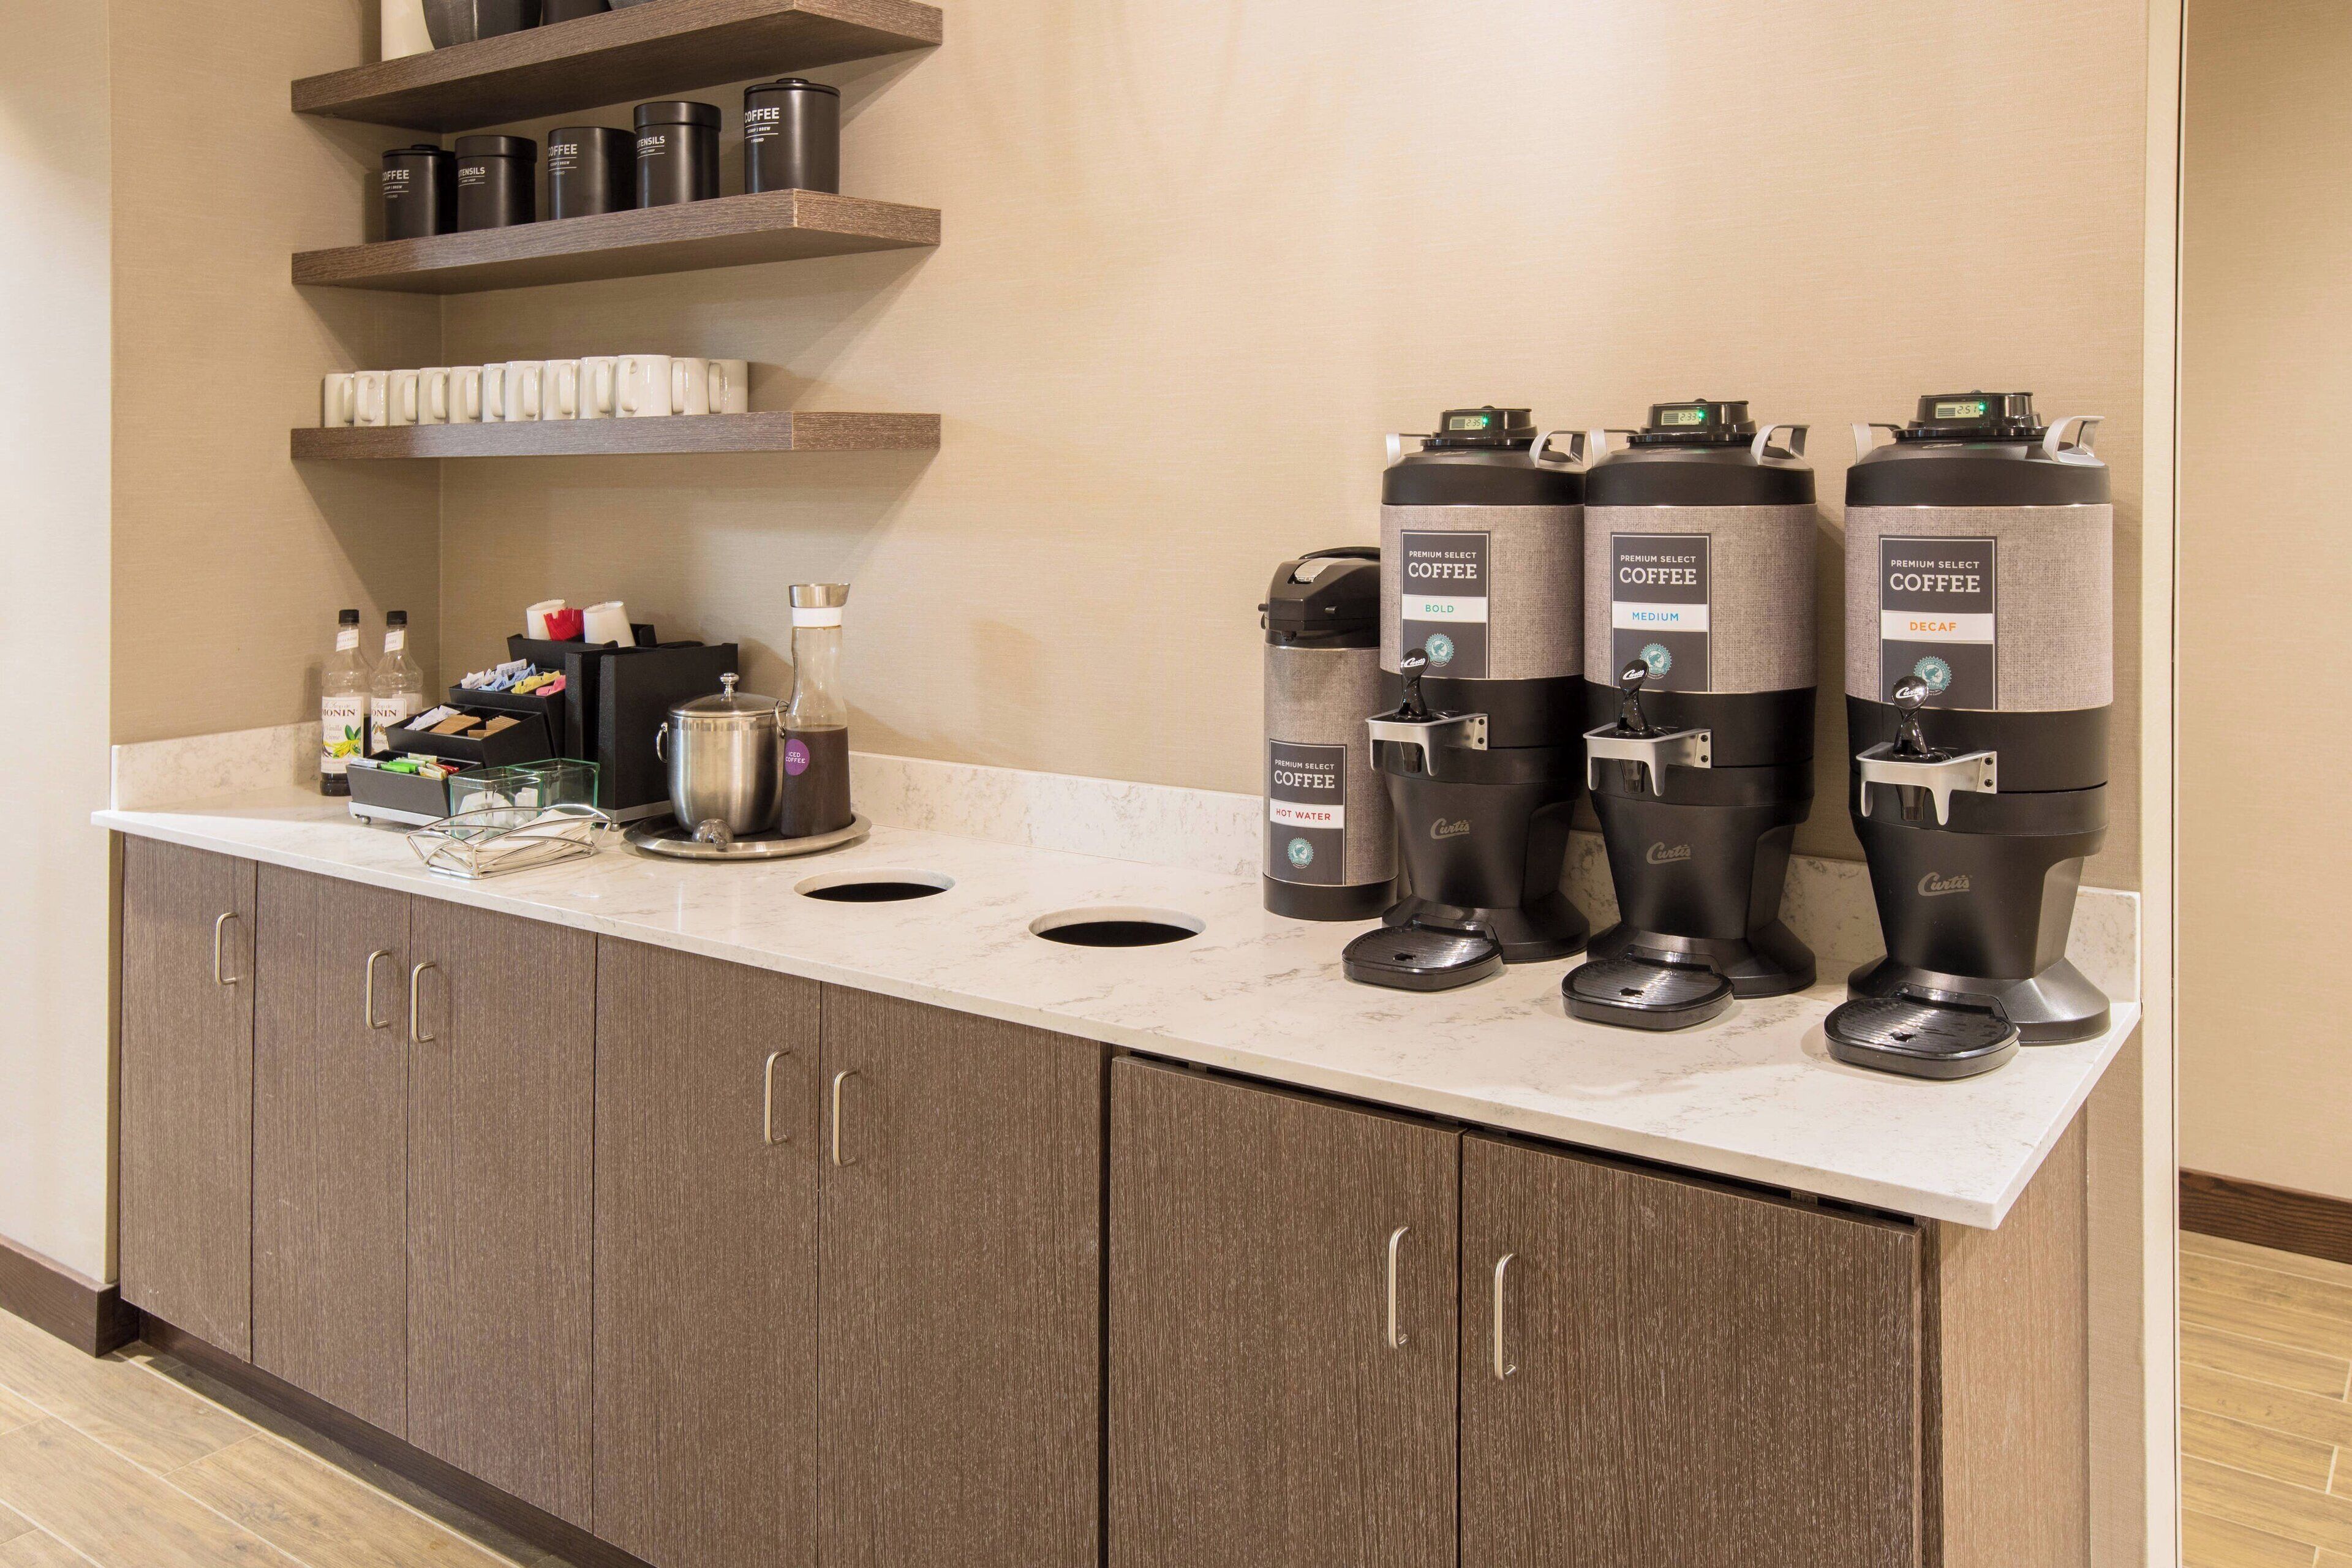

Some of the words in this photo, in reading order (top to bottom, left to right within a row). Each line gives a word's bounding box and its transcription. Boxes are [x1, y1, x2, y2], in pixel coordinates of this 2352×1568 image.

[744, 107, 780, 123] COFFEE
[636, 135, 665, 149] UTENSILS
[548, 144, 578, 157] COFFEE
[1408, 562, 1477, 579] COFFEE
[1891, 559, 1934, 568] PREMIUM
[1619, 567, 1697, 585] COFFEE
[1890, 573, 1980, 592] COFFEE
[1425, 604, 1454, 613] BOLD
[1632, 612, 1679, 621] MEDIUM
[1910, 621, 1956, 631] DECAF
[1275, 759, 1303, 768] PREMIUM
[1274, 770, 1335, 789] COFFEE
[1276, 808, 1292, 818] HOT
[1295, 811, 1331, 821] WATER
[1430, 818, 1470, 840] Curtis
[1646, 842, 1691, 865] Curtis
[1917, 872, 1970, 897] Curtis
